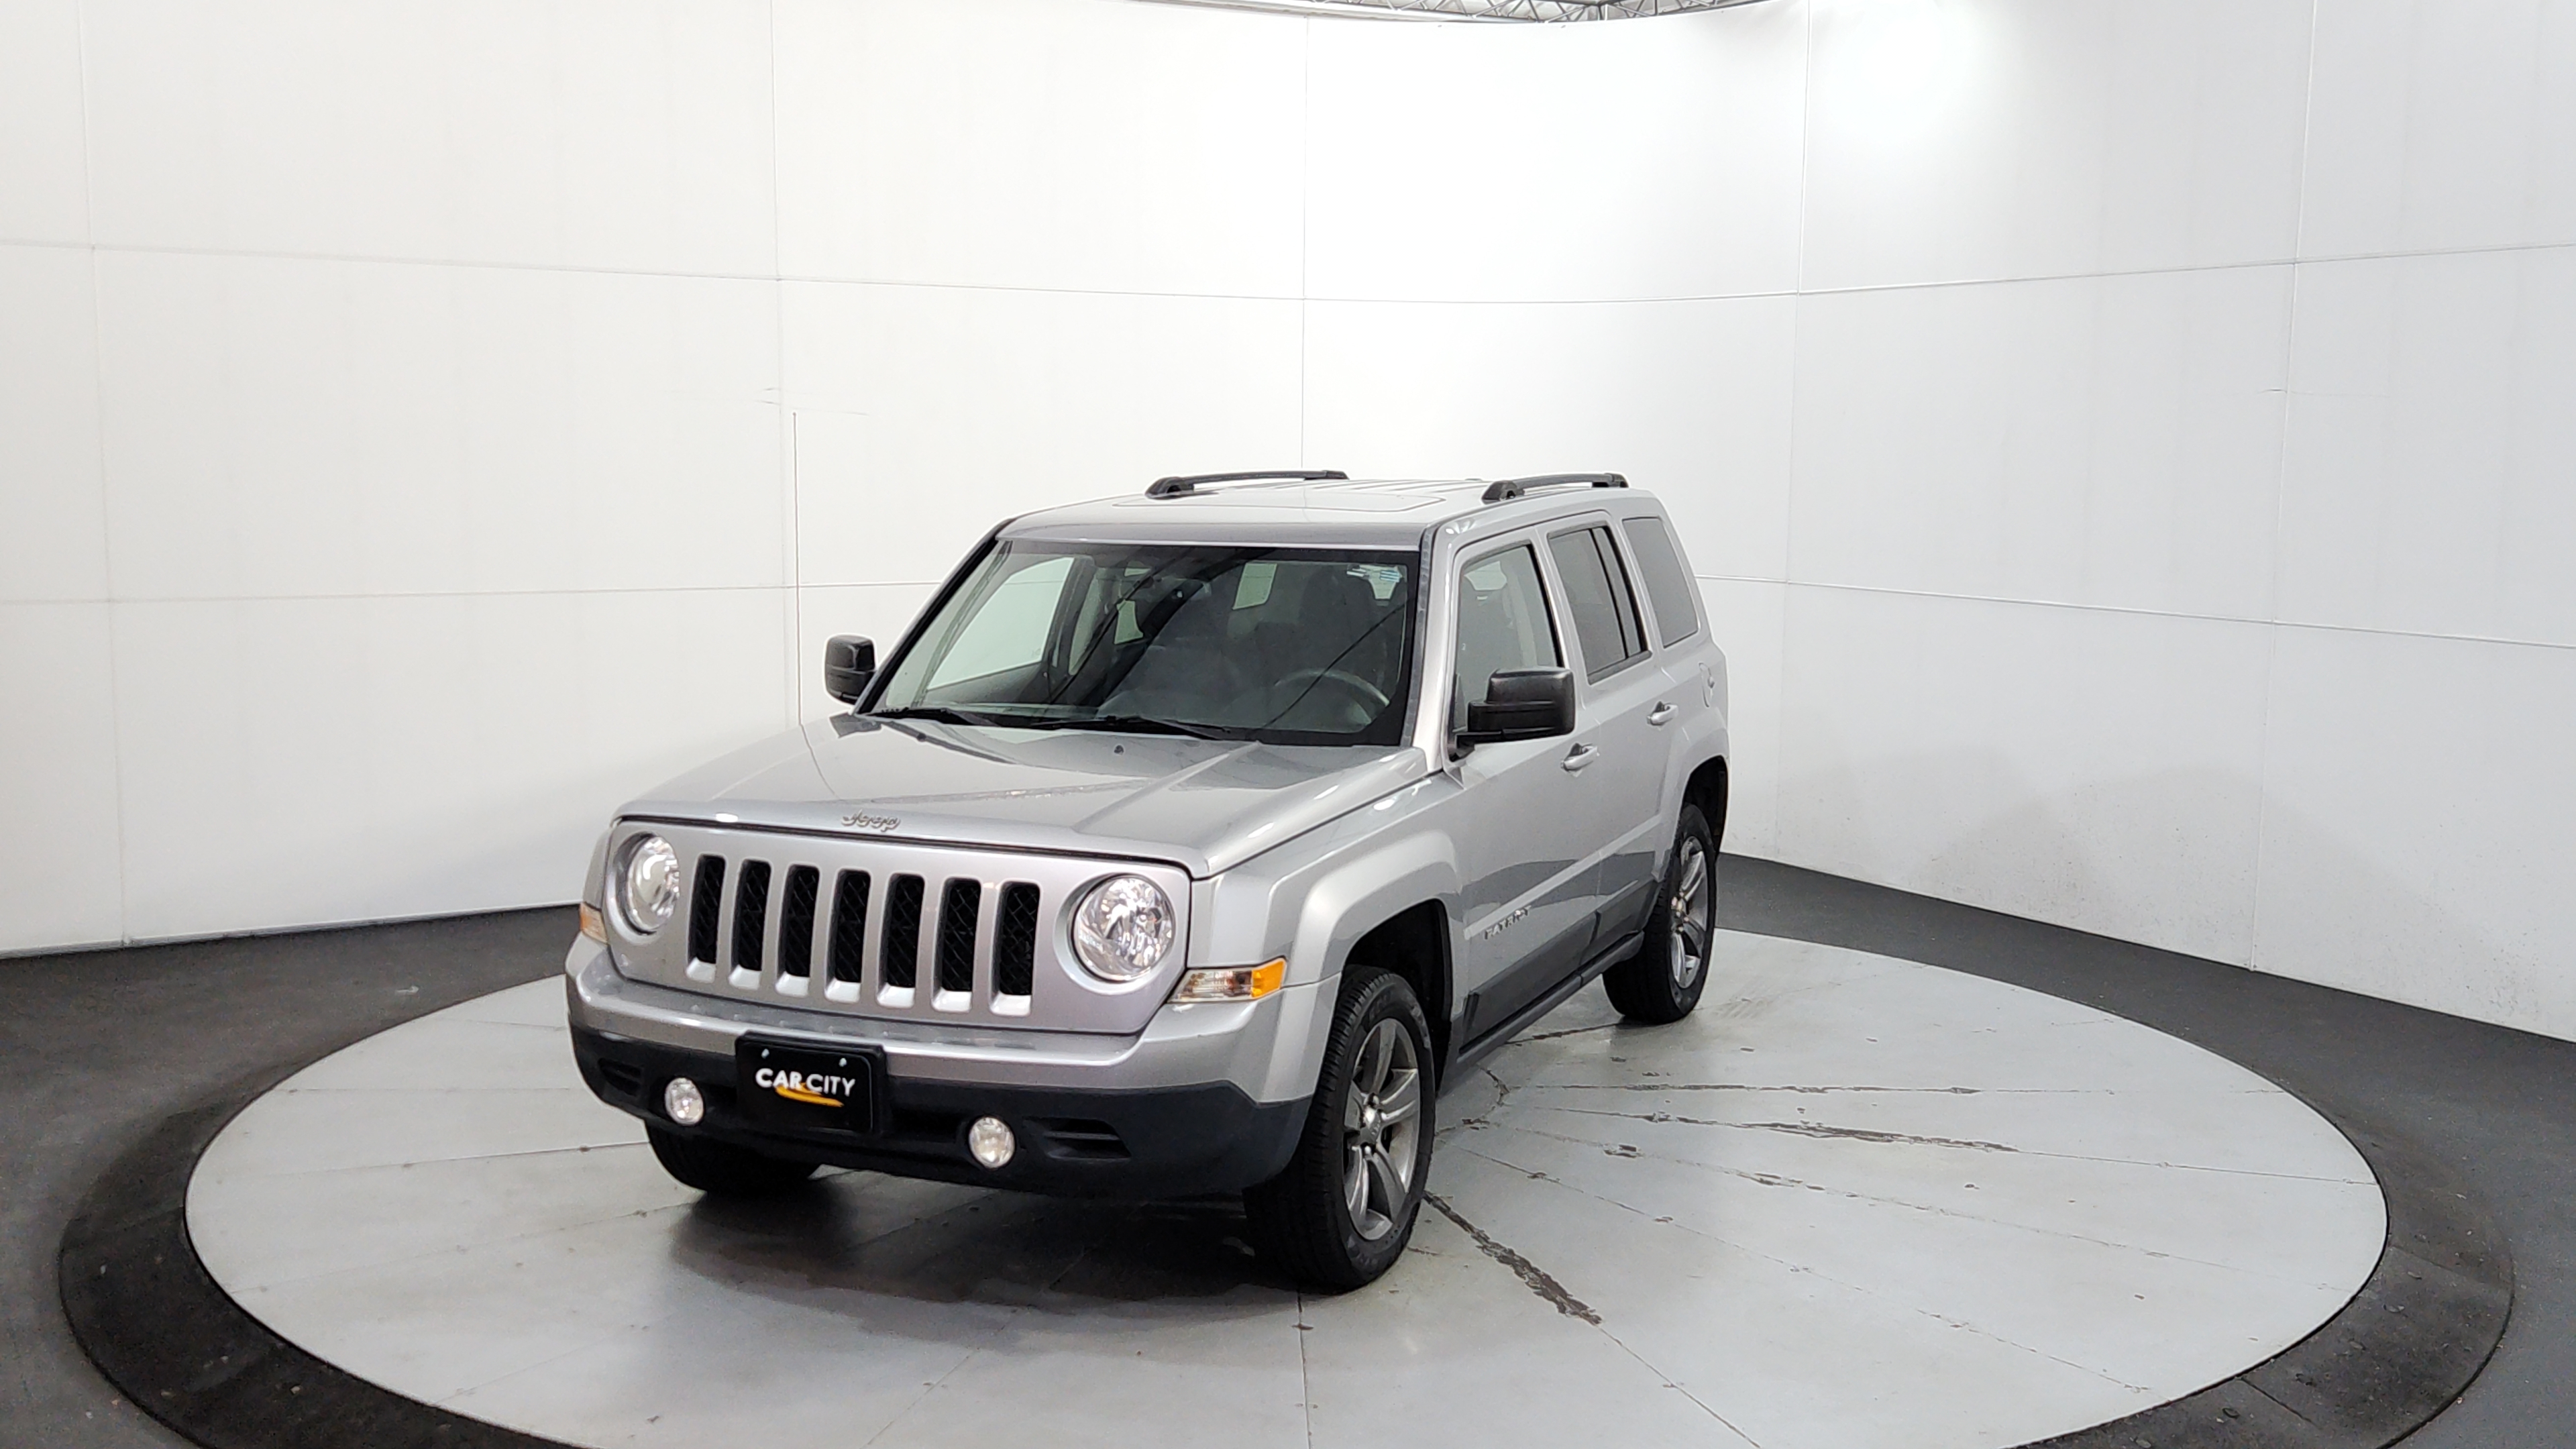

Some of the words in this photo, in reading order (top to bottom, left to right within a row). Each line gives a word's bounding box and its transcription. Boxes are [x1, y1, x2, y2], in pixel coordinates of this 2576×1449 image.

[841, 809, 901, 833] Jeep
[755, 1068, 802, 1090] CAR
[806, 1074, 855, 1096] CITY
